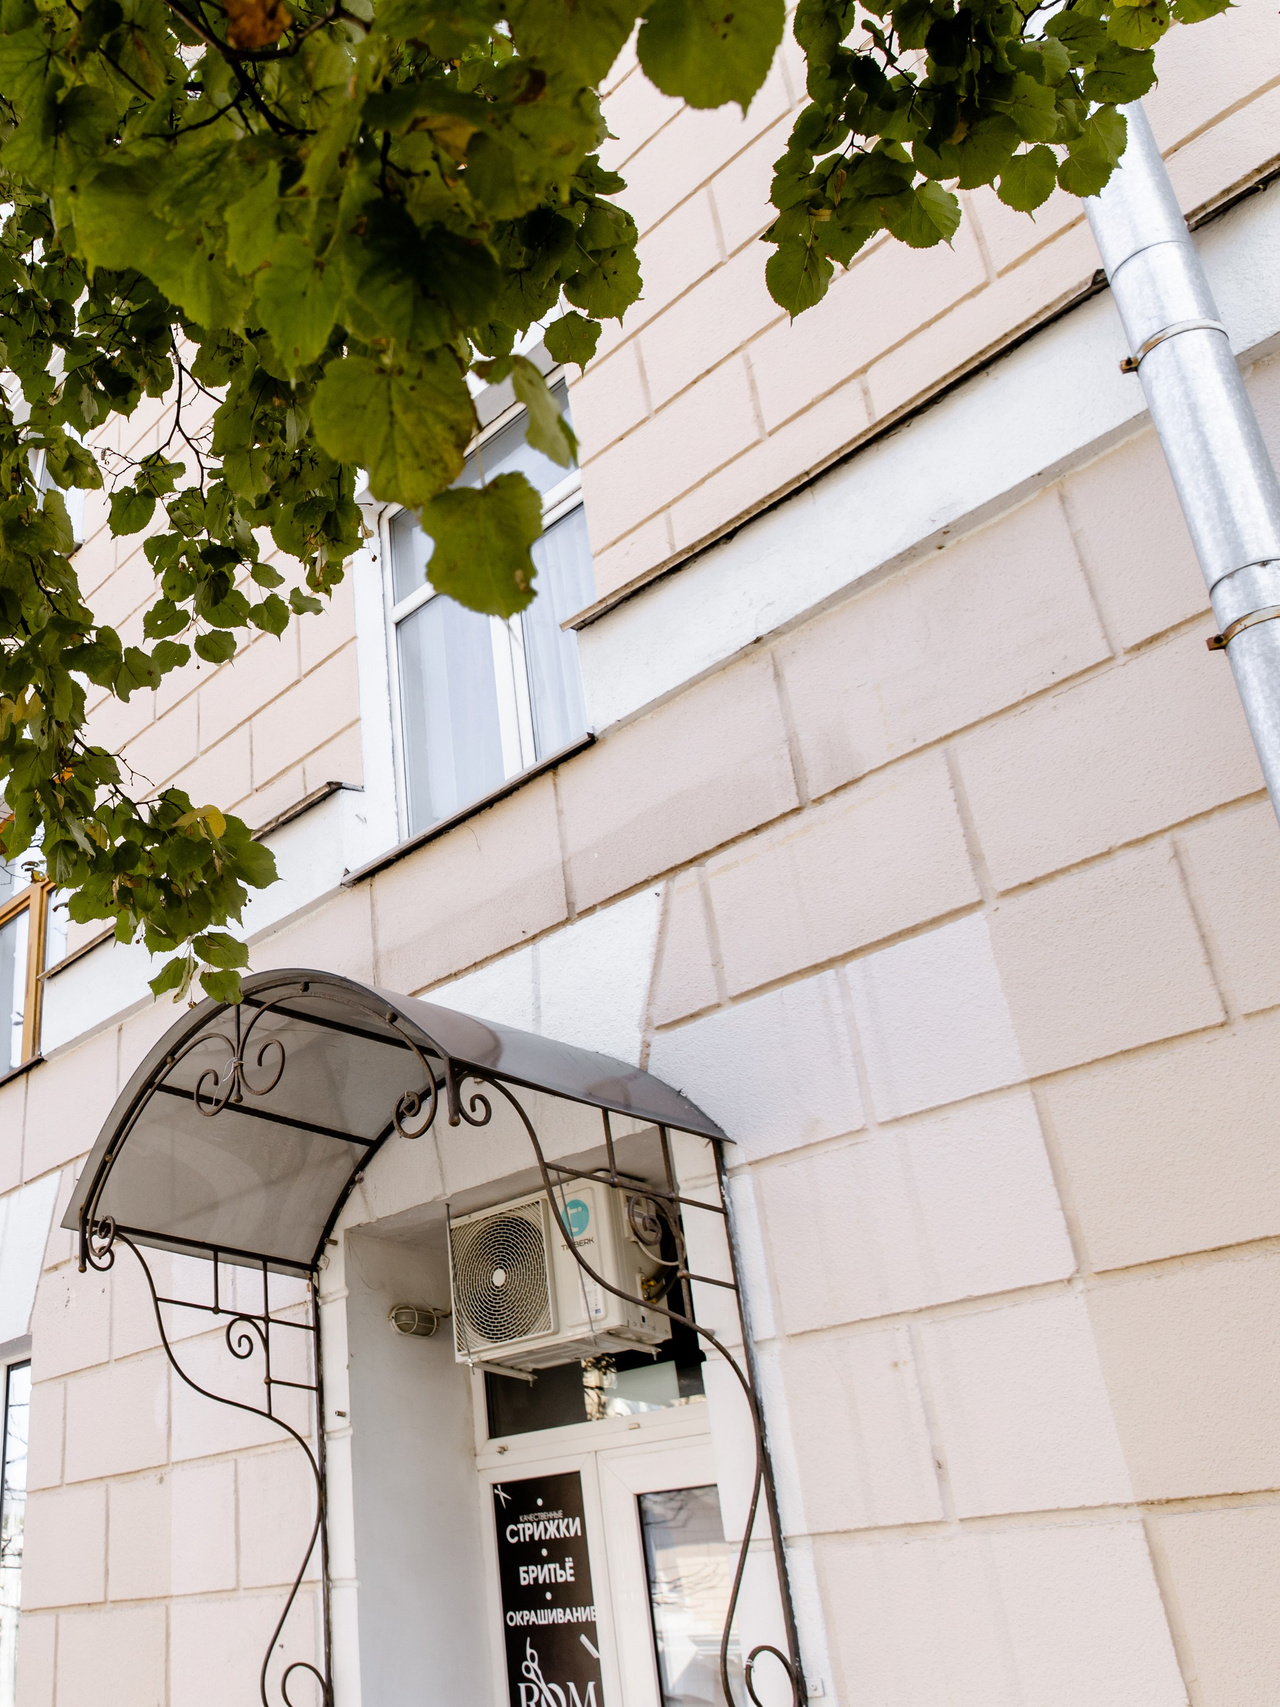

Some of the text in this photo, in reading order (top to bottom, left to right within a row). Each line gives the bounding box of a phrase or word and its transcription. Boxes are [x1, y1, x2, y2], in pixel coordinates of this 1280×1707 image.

[561, 1238, 595, 1252] TIBERK
[518, 1509, 564, 1523] КАЧЕСТВЕННЫЕ
[506, 1516, 582, 1544] СТРИЖКИ
[519, 1557, 575, 1586] БРИТЬЁ
[506, 1605, 597, 1627] ОКРАШИВАНИЕ
